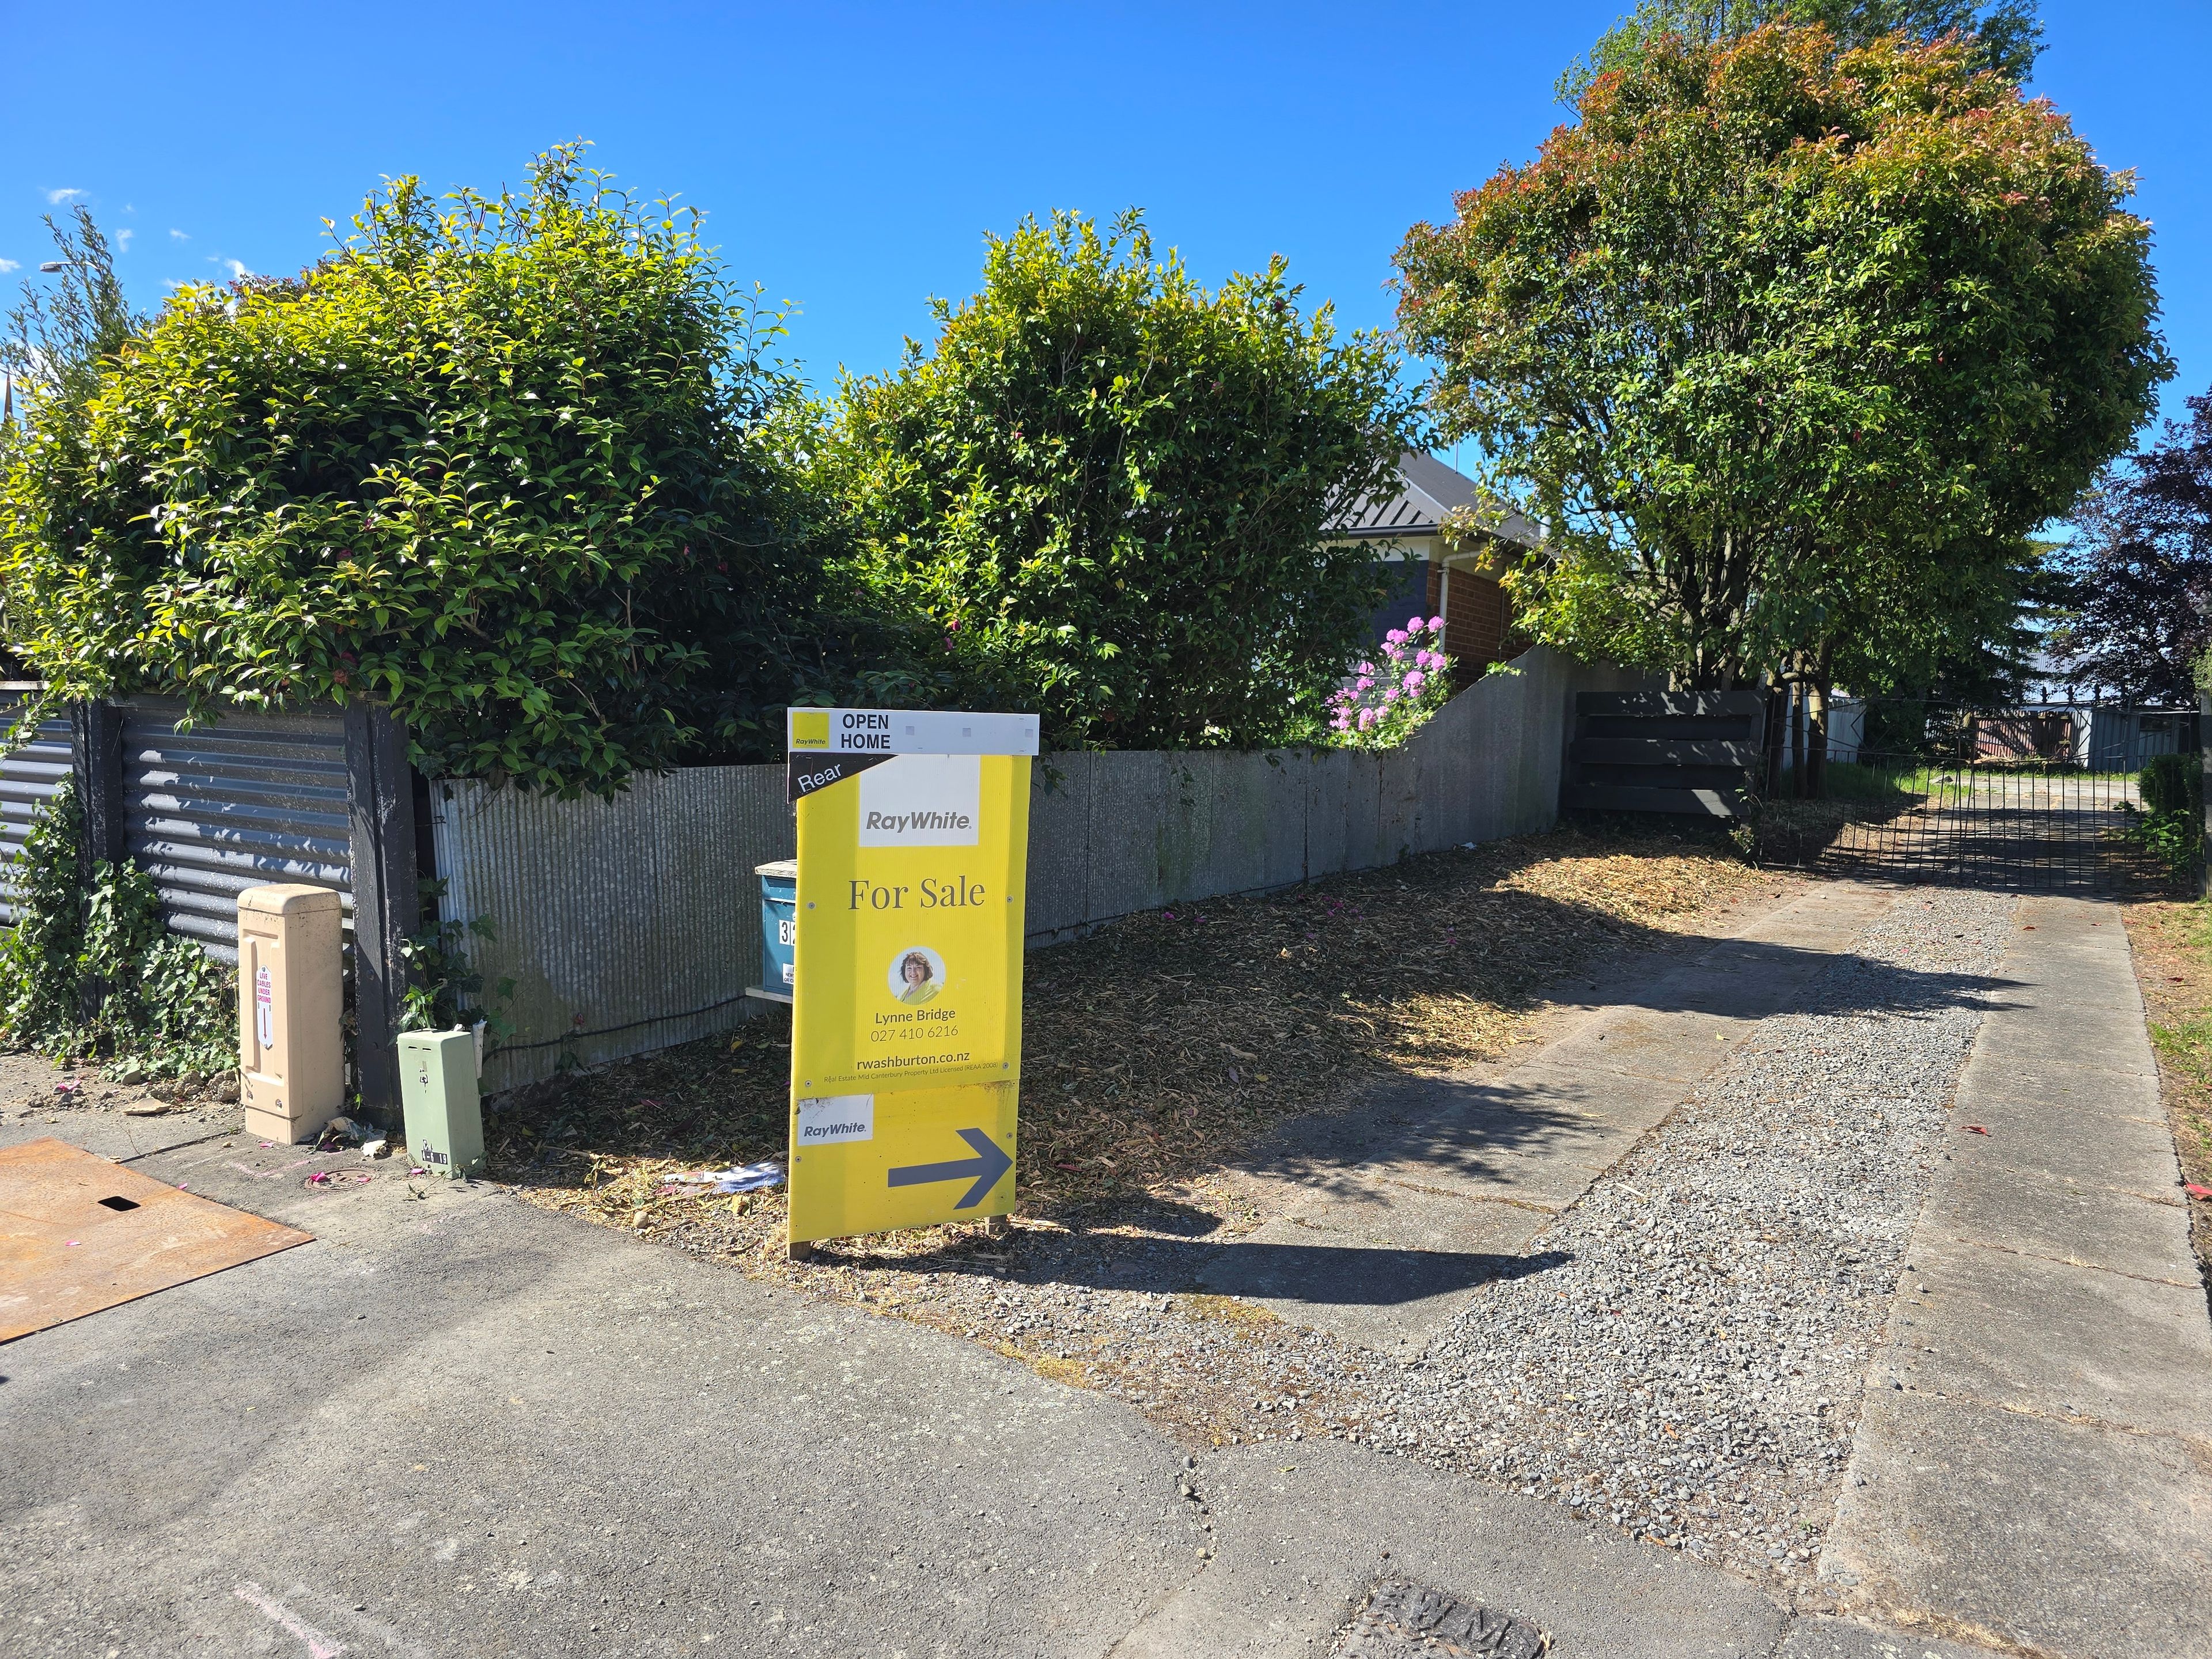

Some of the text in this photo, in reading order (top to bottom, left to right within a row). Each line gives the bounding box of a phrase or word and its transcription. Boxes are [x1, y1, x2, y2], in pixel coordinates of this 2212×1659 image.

[842, 713, 889, 729] OPEN
[840, 733, 891, 749] HOME
[797, 763, 842, 793] Rear
[848, 875, 985, 910] For Sale
[257, 979, 271, 988] CABLES
[257, 987, 270, 995] UNDER
[257, 995, 271, 1003] GROUND
[875, 1007, 956, 1026] Lynne Bridge
[870, 1024, 959, 1043] 027 410 6216
[857, 1052, 970, 1070] rwashburton.co.nz
[824, 1075, 837, 1083] Real
[870, 1071, 903, 1080] Canterbury
[904, 1069, 929, 1078] Property
[940, 1065, 964, 1074] Licensed
[964, 1063, 982, 1071] (REAA
[982, 1061, 999, 1069] 2008)
